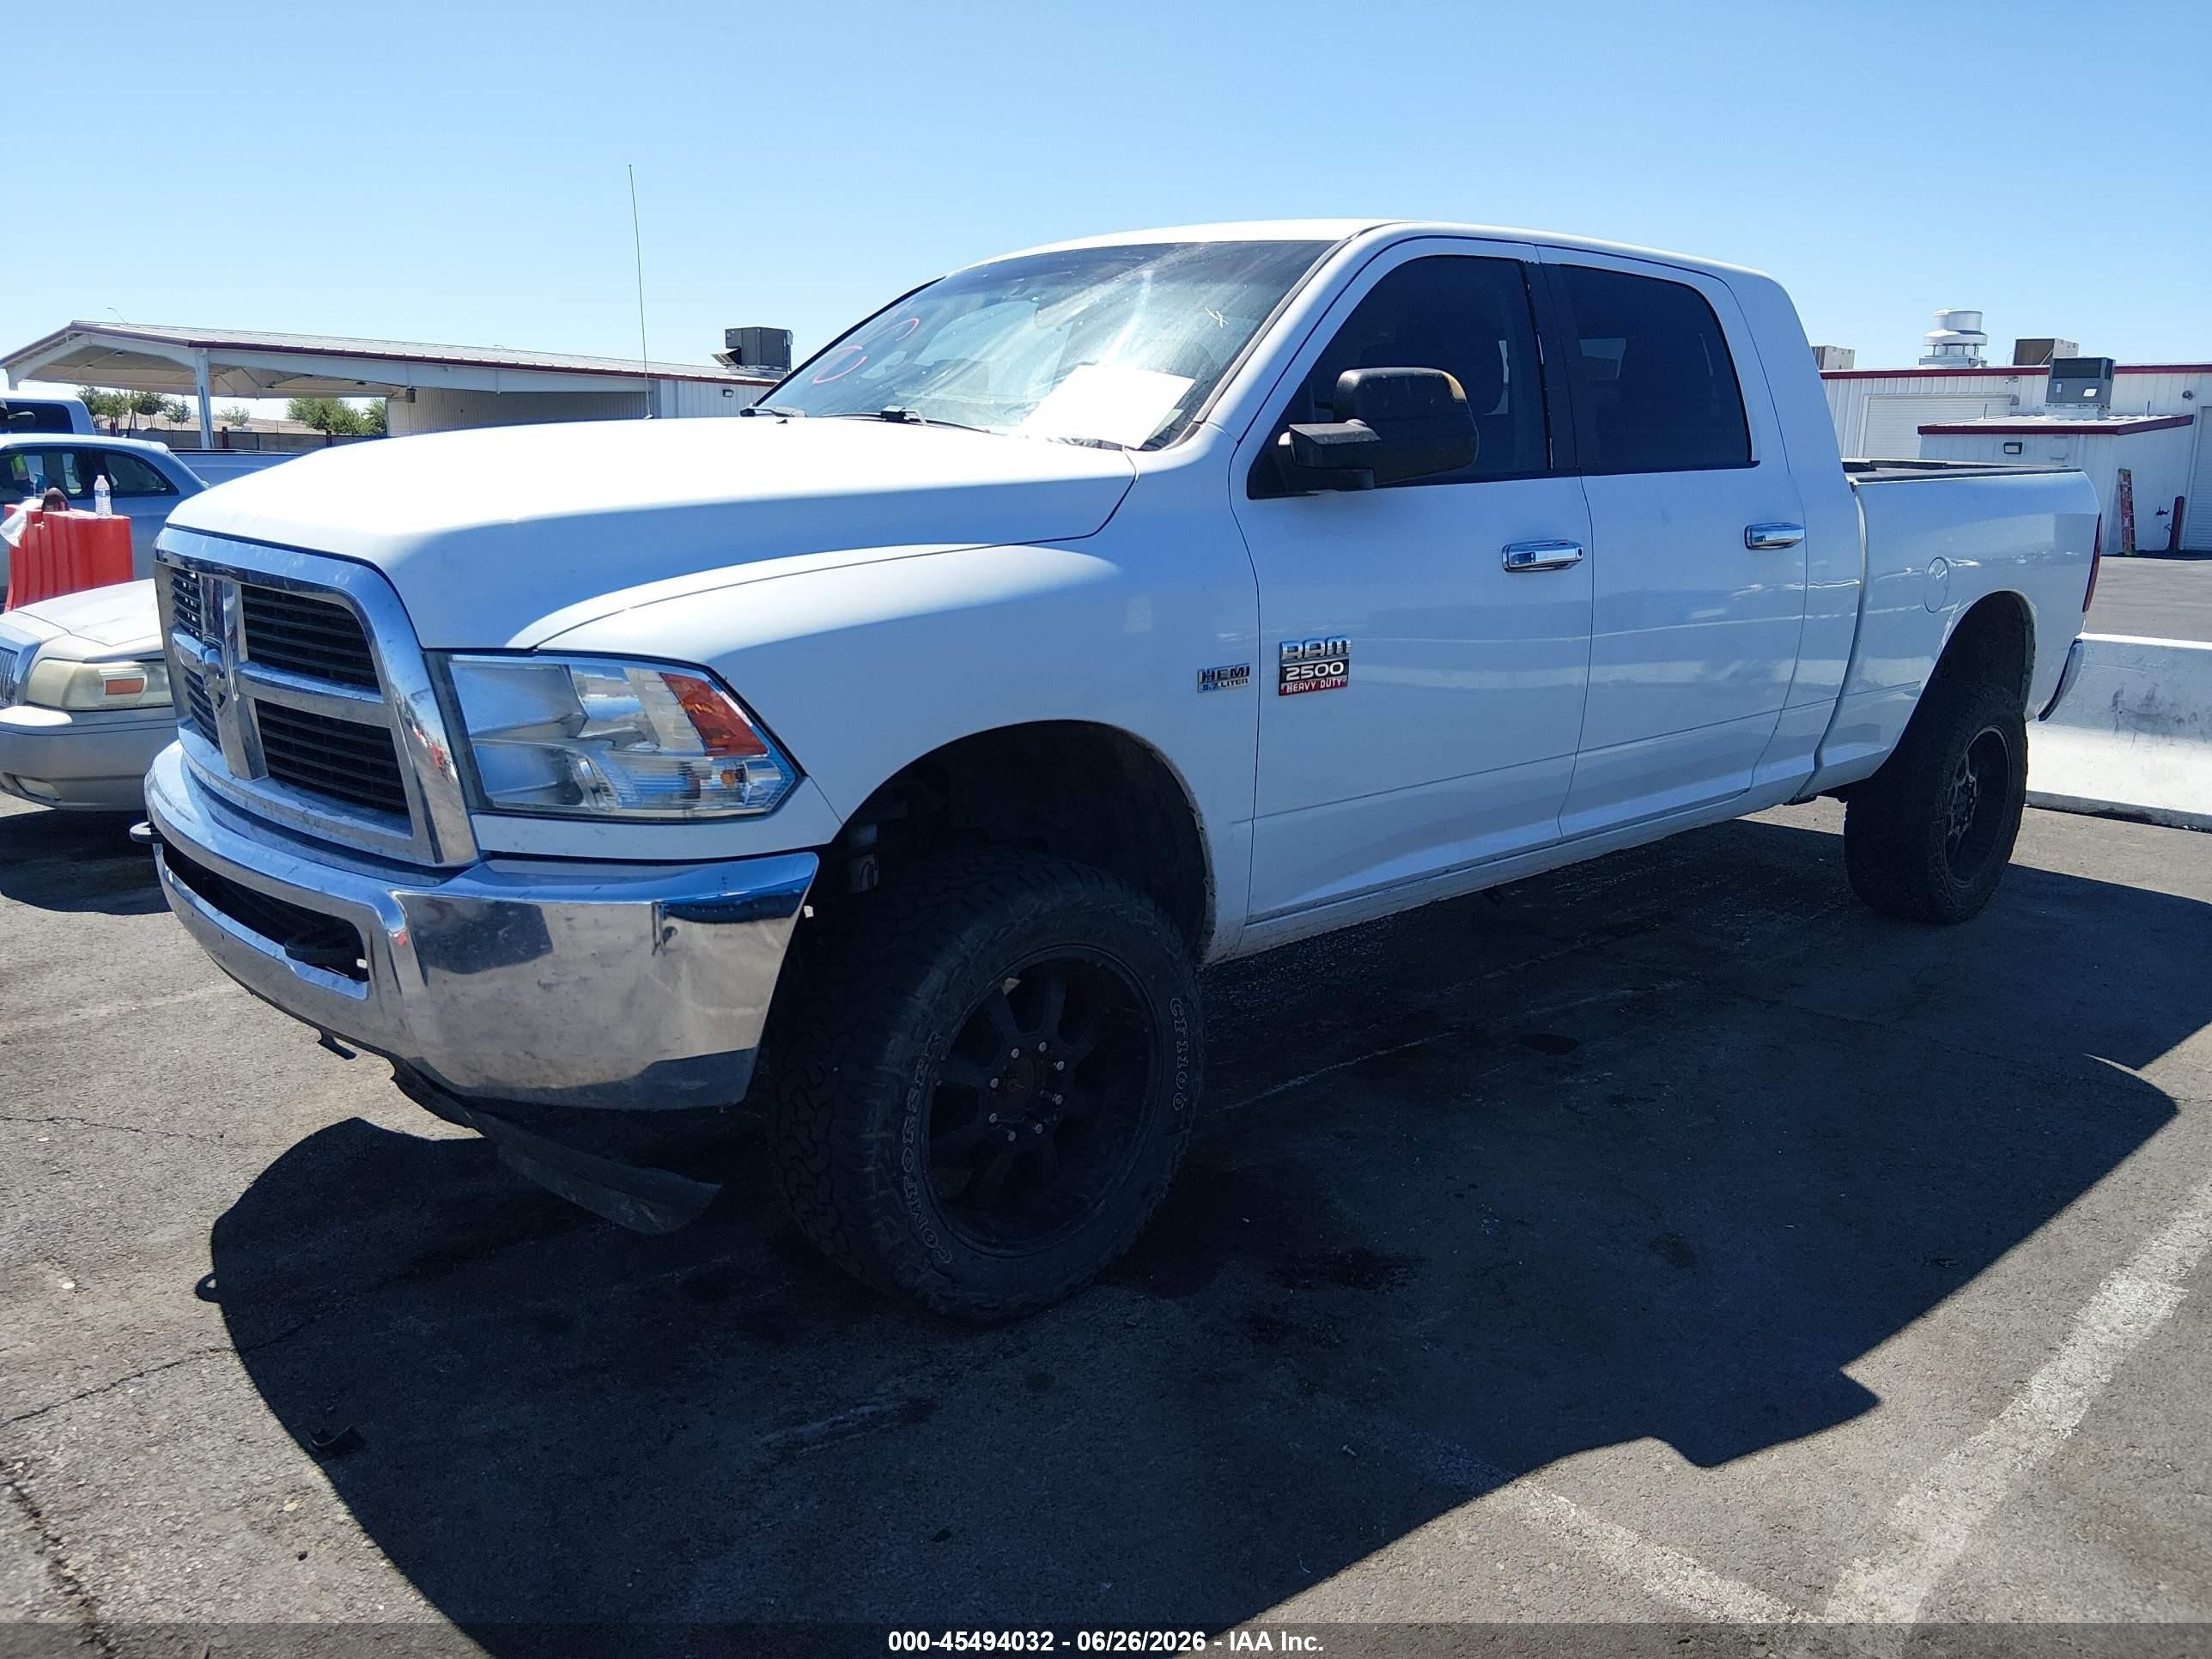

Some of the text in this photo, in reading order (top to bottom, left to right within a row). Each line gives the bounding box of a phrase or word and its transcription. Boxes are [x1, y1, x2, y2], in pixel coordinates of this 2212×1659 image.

[1281, 636, 1351, 660] RAM
[1200, 664, 1250, 684] HEMI
[1285, 661, 1344, 681] 2500
[1220, 678, 1249, 689] LITER
[1286, 678, 1344, 693] HEAVY DUTY
